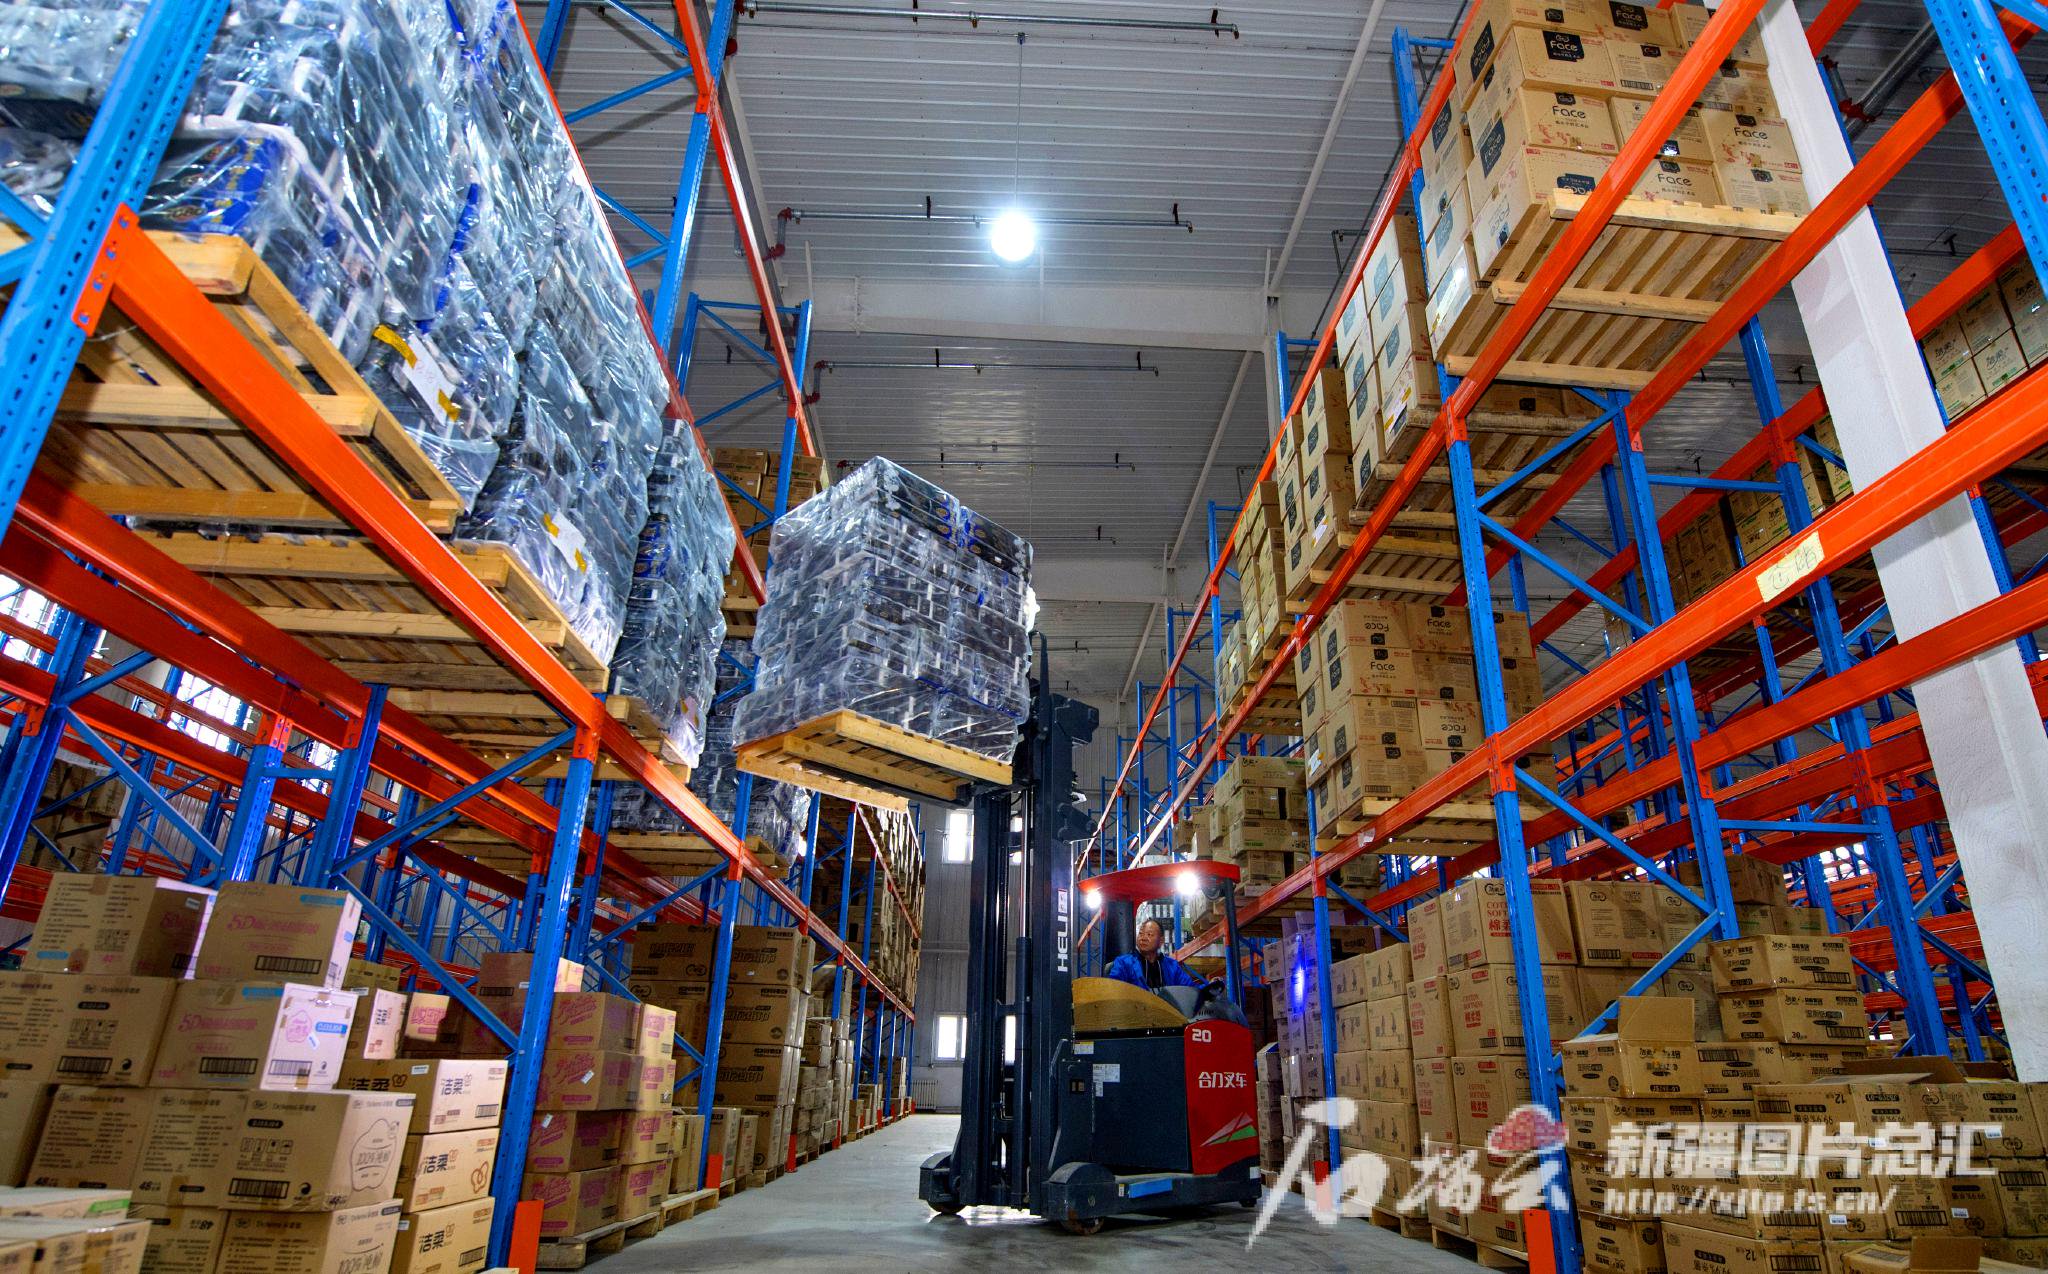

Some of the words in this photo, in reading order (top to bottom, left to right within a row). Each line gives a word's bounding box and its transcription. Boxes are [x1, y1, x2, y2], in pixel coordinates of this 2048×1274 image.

[1550, 40, 1578, 52] Face
[1552, 105, 1586, 119] Face
[1734, 127, 1768, 140] Face
[1658, 173, 1693, 187] Face
[1364, 622, 1389, 633] Face
[1427, 619, 1452, 628] Face
[1370, 661, 1395, 671] Face
[1441, 723, 1467, 734] Face
[1487, 902, 1508, 910] COT
[1487, 909, 1509, 917] SOFT
[1489, 919, 1511, 931] 棉柔
[1057, 915, 1068, 972] HELI
[1192, 1028, 1211, 1042] 20
[1791, 1031, 1801, 1039] 30
[1765, 1047, 1774, 1055] 30
[1198, 1071, 1247, 1088] 合力叉车
[440, 1078, 464, 1096] 洁柔
[1834, 1093, 1846, 1104] 12
[423, 1153, 449, 1174] 洁柔
[418, 1229, 446, 1254] 洁柔
[1745, 1249, 1756, 1261] 12
